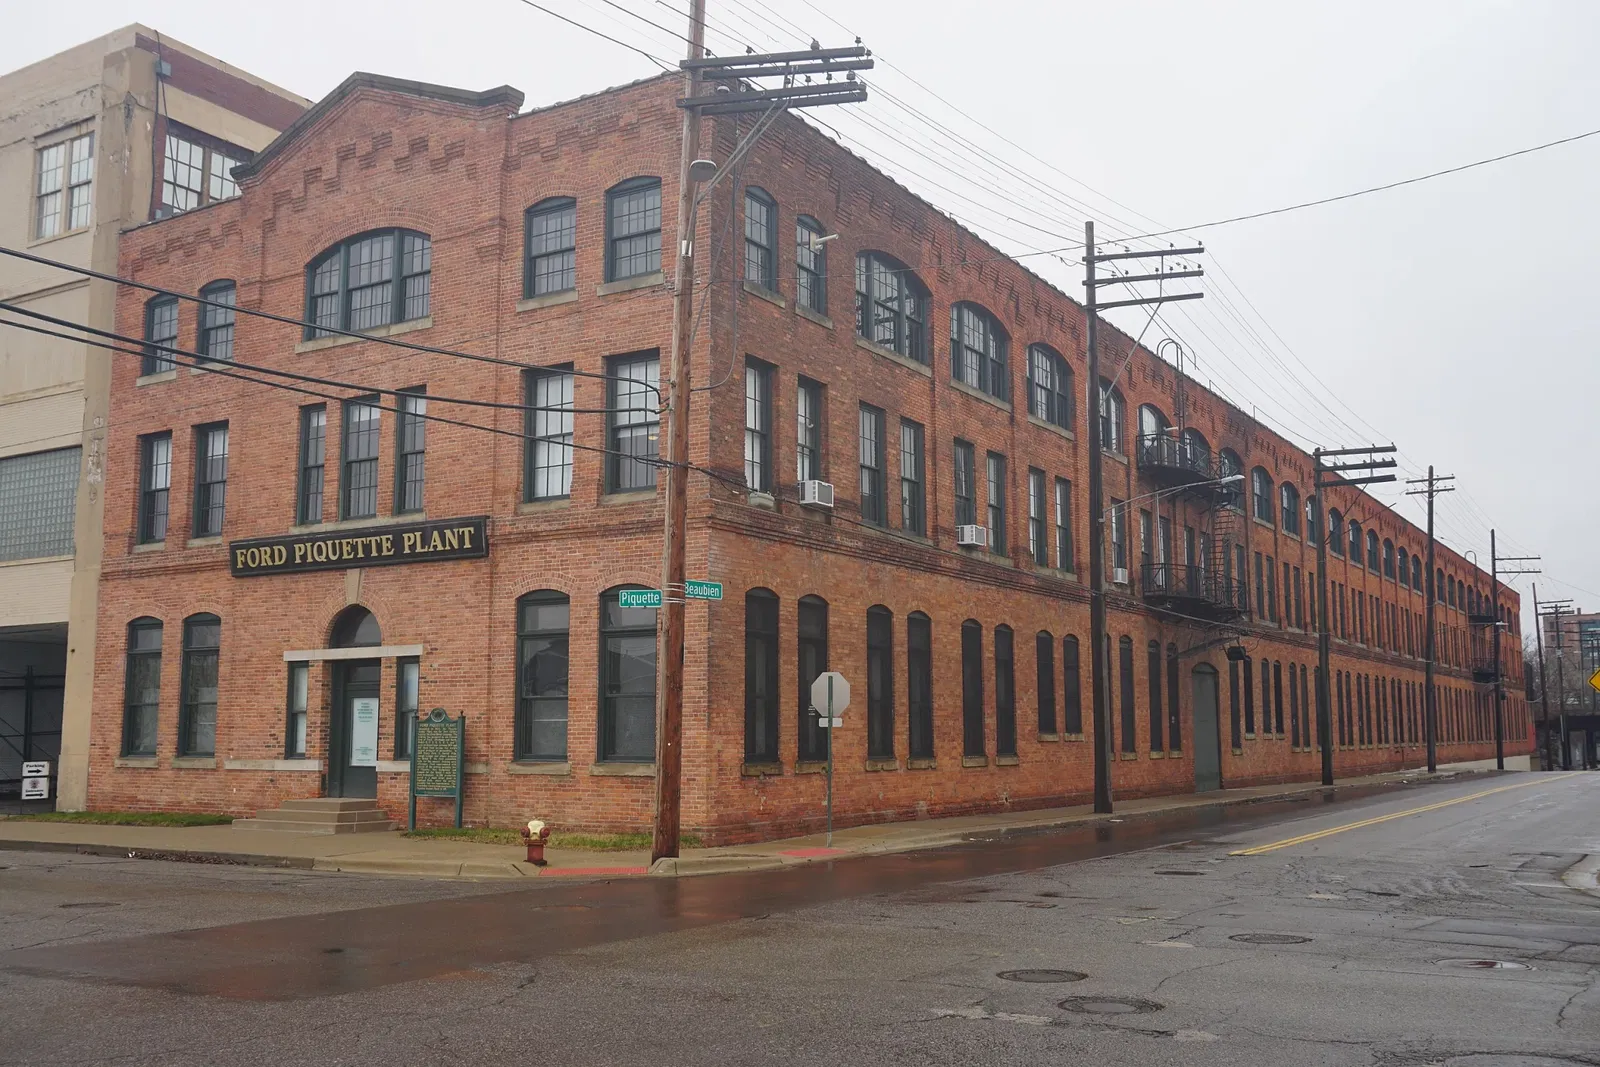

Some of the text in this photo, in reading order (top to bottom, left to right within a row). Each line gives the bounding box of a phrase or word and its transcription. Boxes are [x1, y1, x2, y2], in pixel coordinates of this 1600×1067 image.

[236, 526, 475, 568] FORD PIQUETTE PLANT
[685, 582, 719, 596] Beaubien
[621, 592, 660, 606] Piquette
